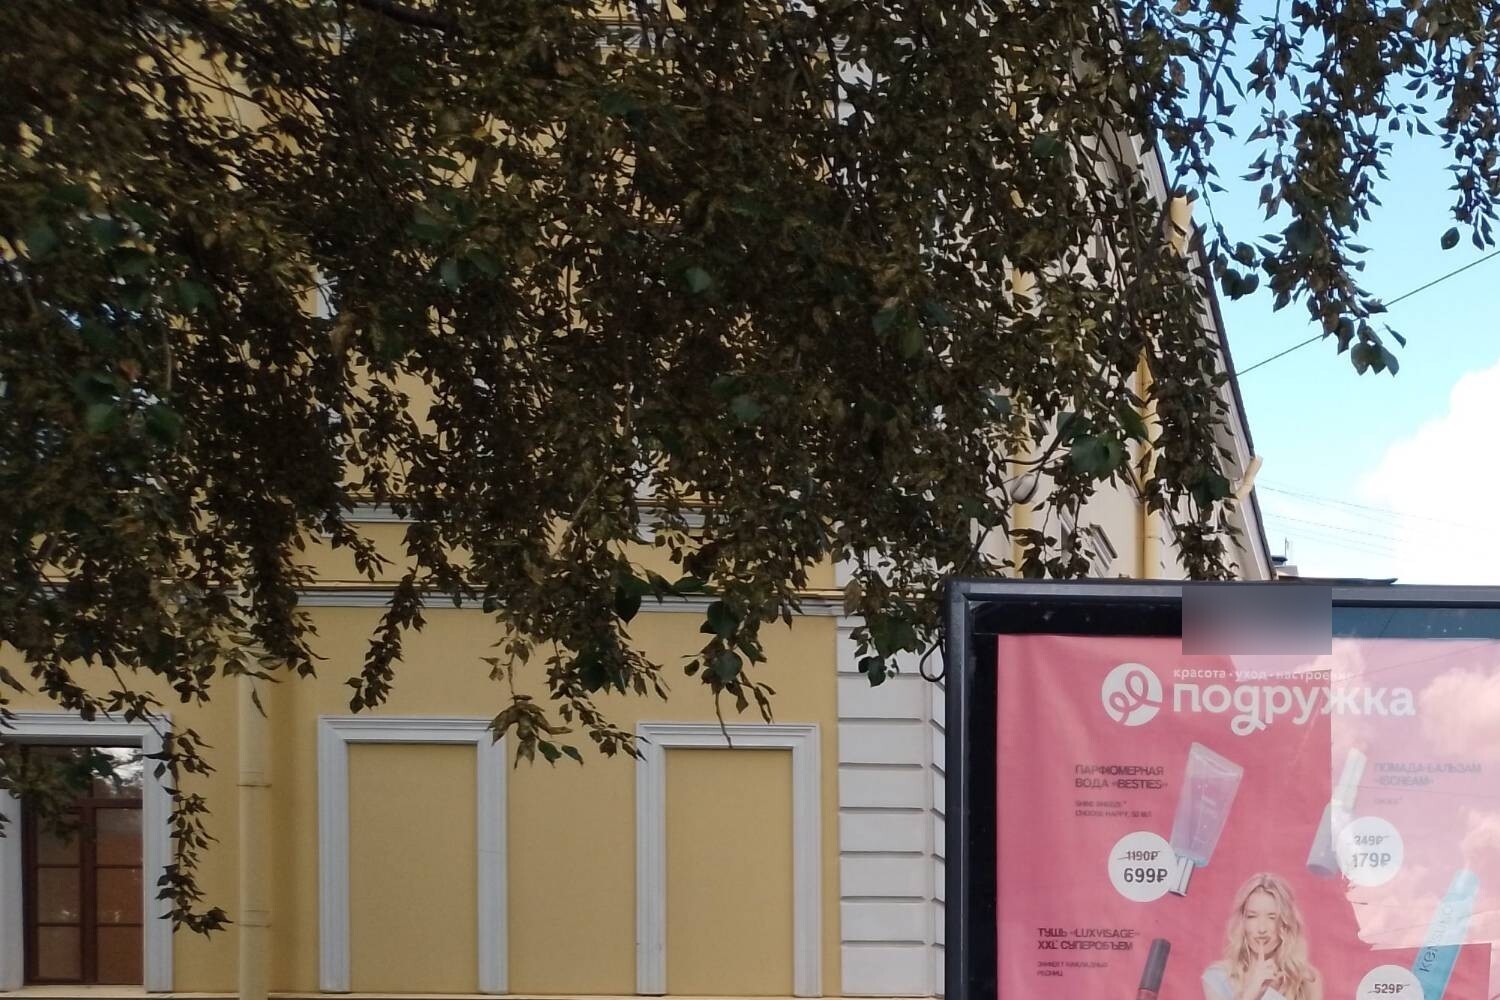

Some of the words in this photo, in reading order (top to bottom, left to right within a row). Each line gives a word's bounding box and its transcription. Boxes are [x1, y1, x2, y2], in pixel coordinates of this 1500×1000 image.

[1173, 669, 1227, 680] красота
[1173, 682, 1417, 737] подружка
[1075, 764, 1165, 776] ПАРФЮМЕРНАЯ
[1075, 778, 1109, 788] ВОДА
